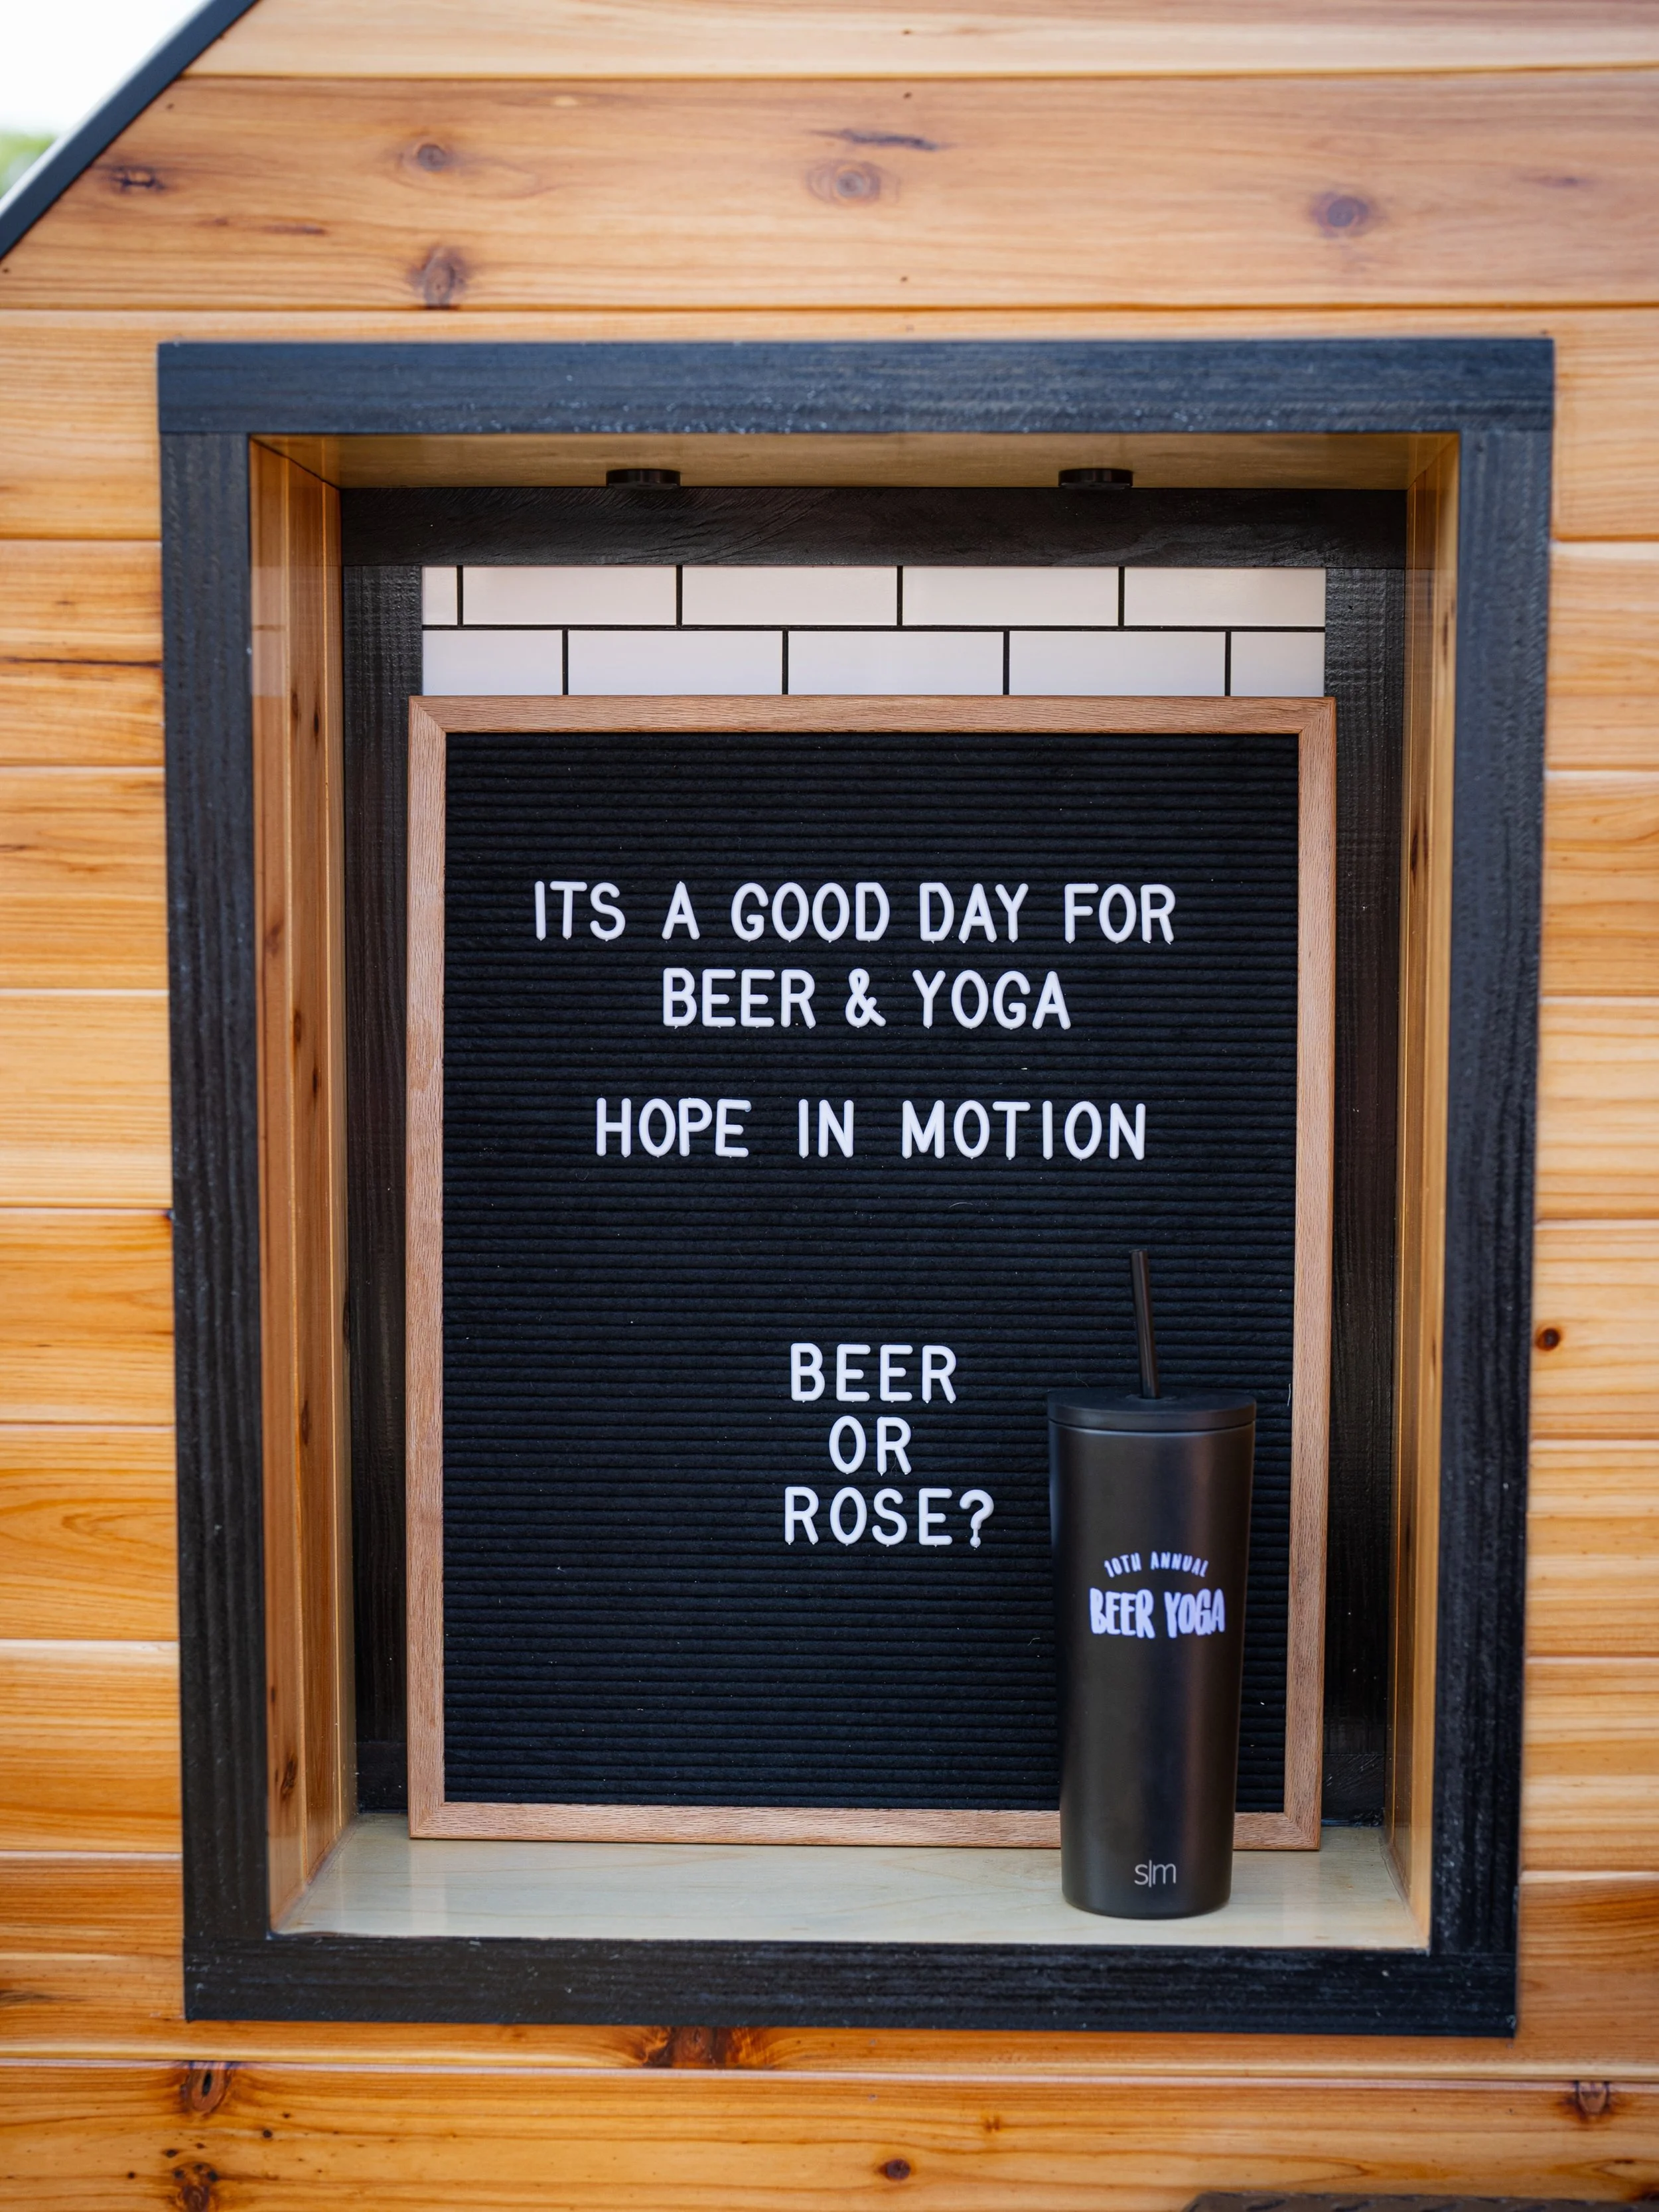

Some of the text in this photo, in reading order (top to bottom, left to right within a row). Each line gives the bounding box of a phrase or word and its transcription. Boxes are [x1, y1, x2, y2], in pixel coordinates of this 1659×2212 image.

[534, 881, 1176, 945] ITS A GOOD DAY FOR
[663, 968, 1071, 1030] BEER & YOGA
[596, 1097, 1146, 1161] HOPE IN MOTION
[790, 1343, 956, 1404] BEER
[829, 1415, 912, 1477] OR
[784, 1486, 994, 1549] ROSE?
[1104, 1551, 1209, 1578] 10TH ANNUAL
[1090, 1587, 1226, 1639] BEER YOGA
